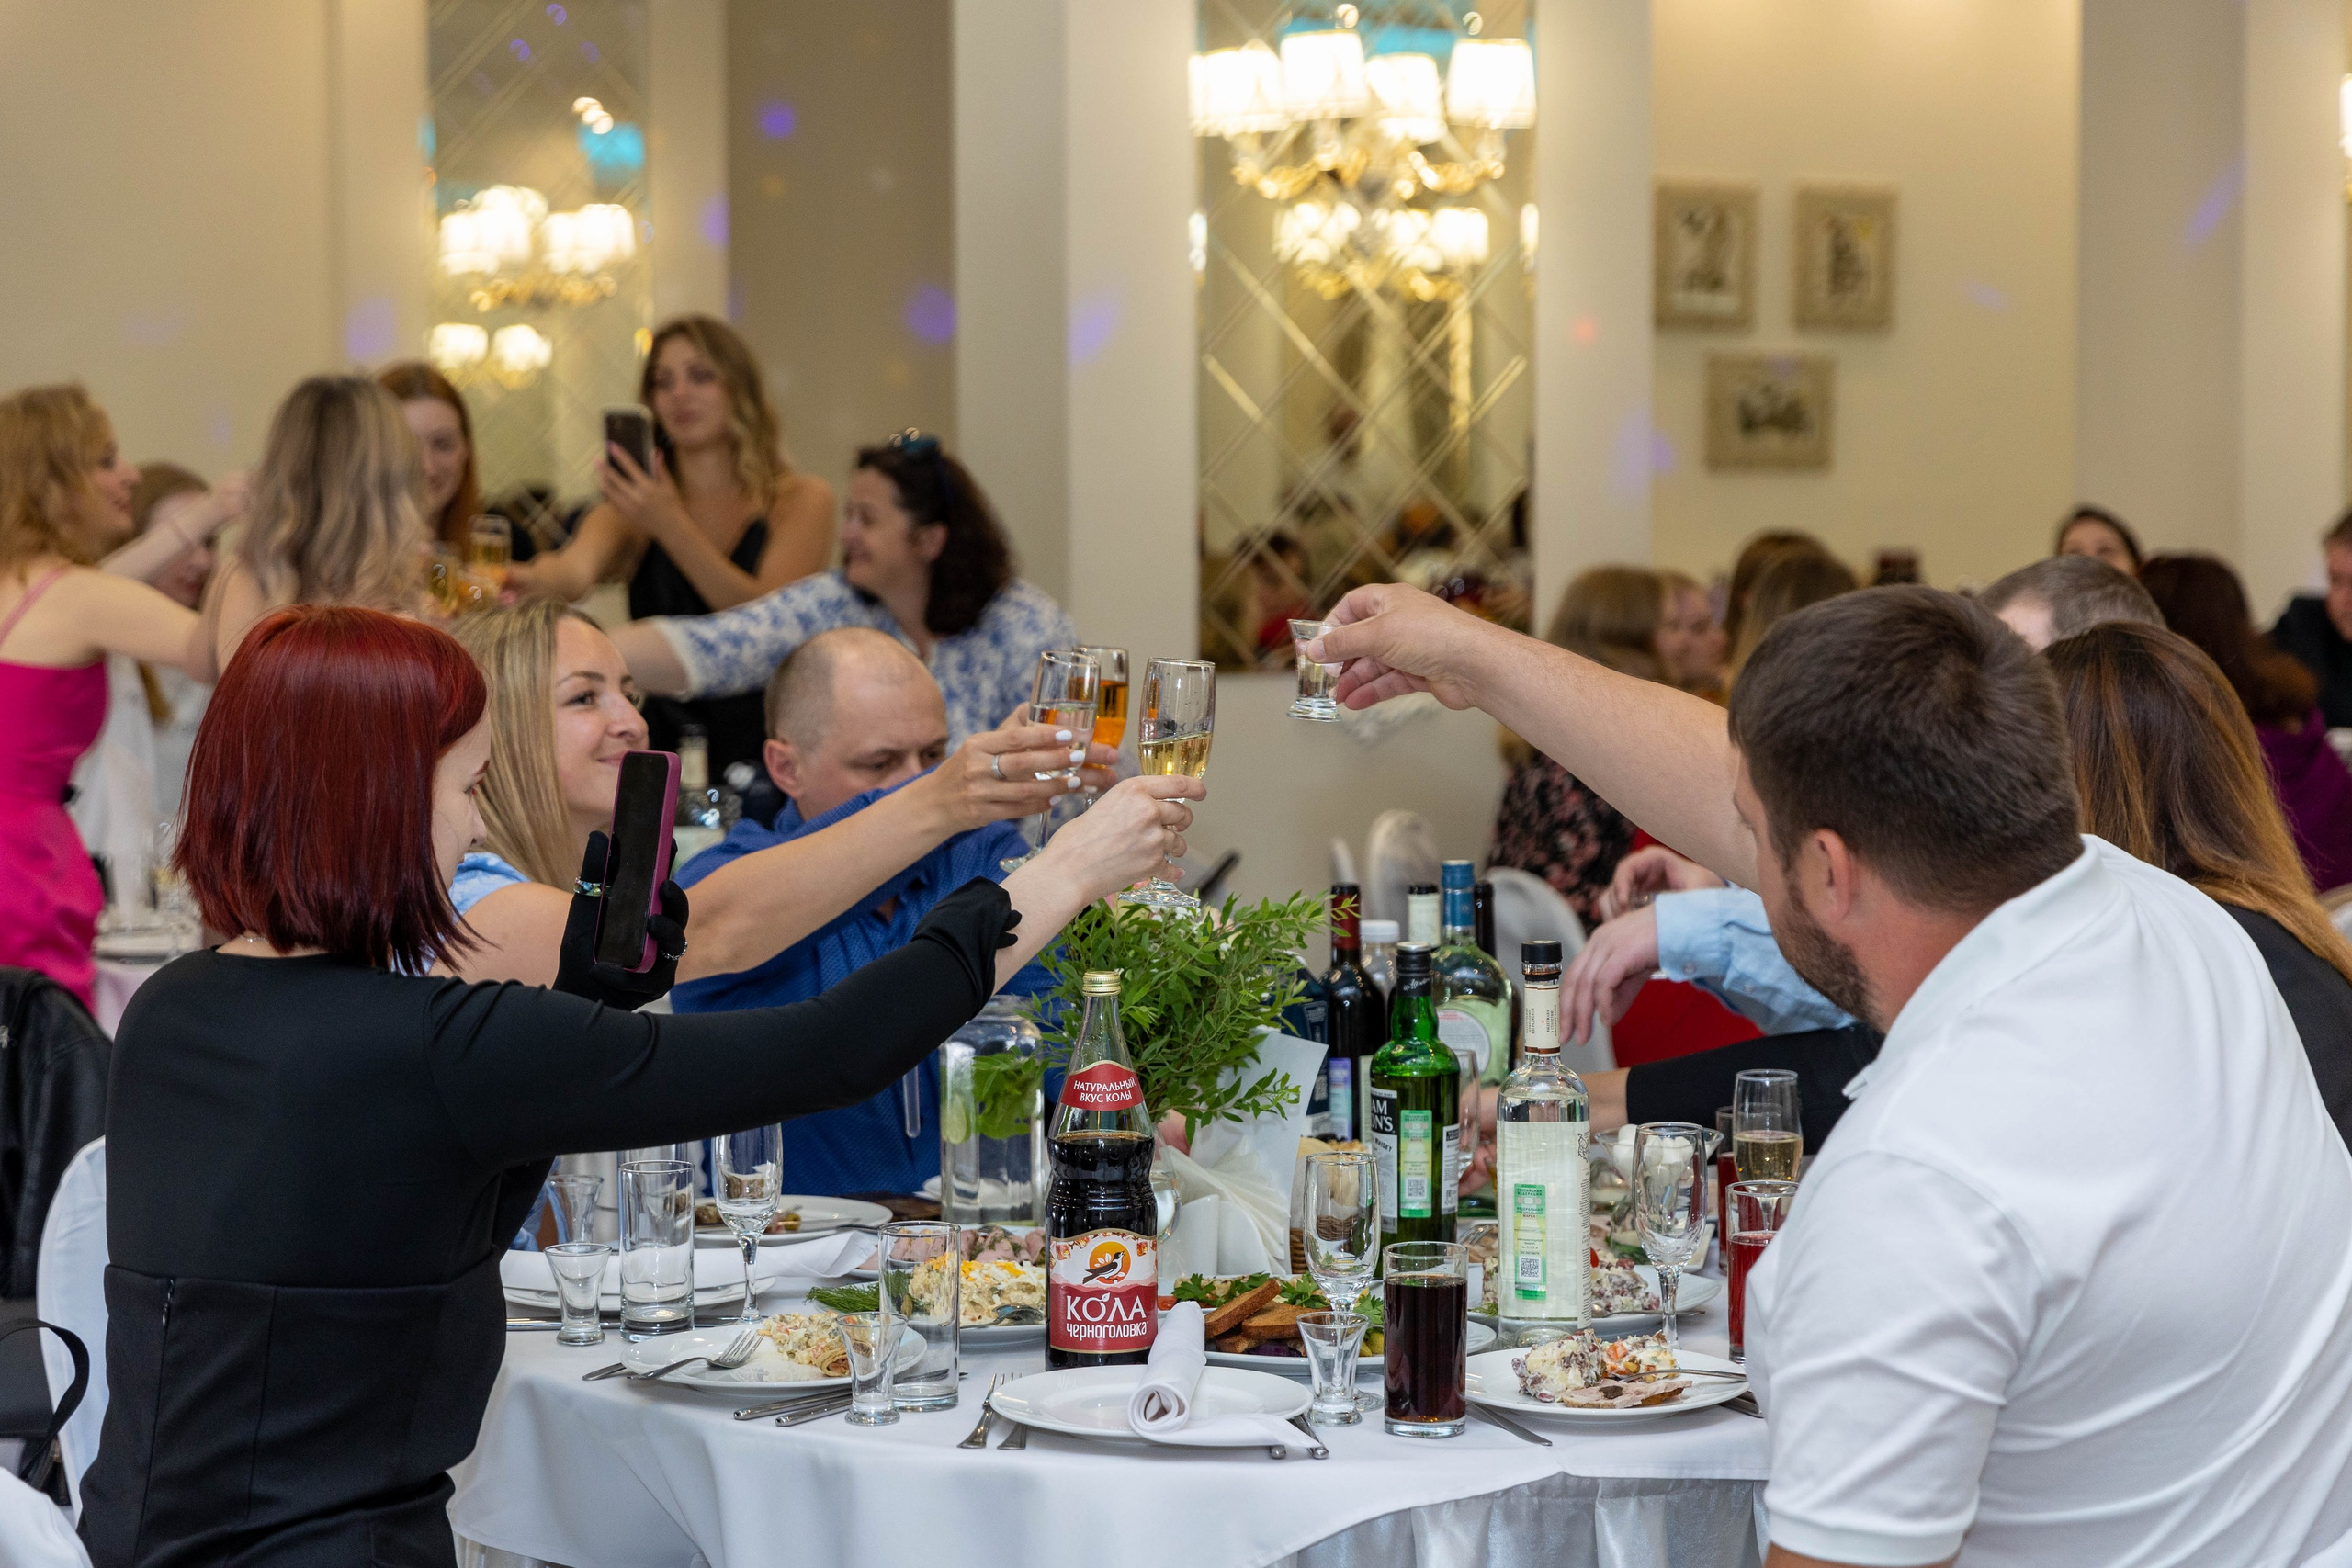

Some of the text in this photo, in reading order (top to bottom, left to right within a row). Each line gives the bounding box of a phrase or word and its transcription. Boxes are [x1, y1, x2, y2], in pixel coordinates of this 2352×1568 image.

[1073, 1076, 1136, 1093] НАТУРАЛЬНЫЙ
[1080, 1089, 1132, 1103] ВКУС КОЛЫ
[1066, 1295, 1147, 1322] КОЛА
